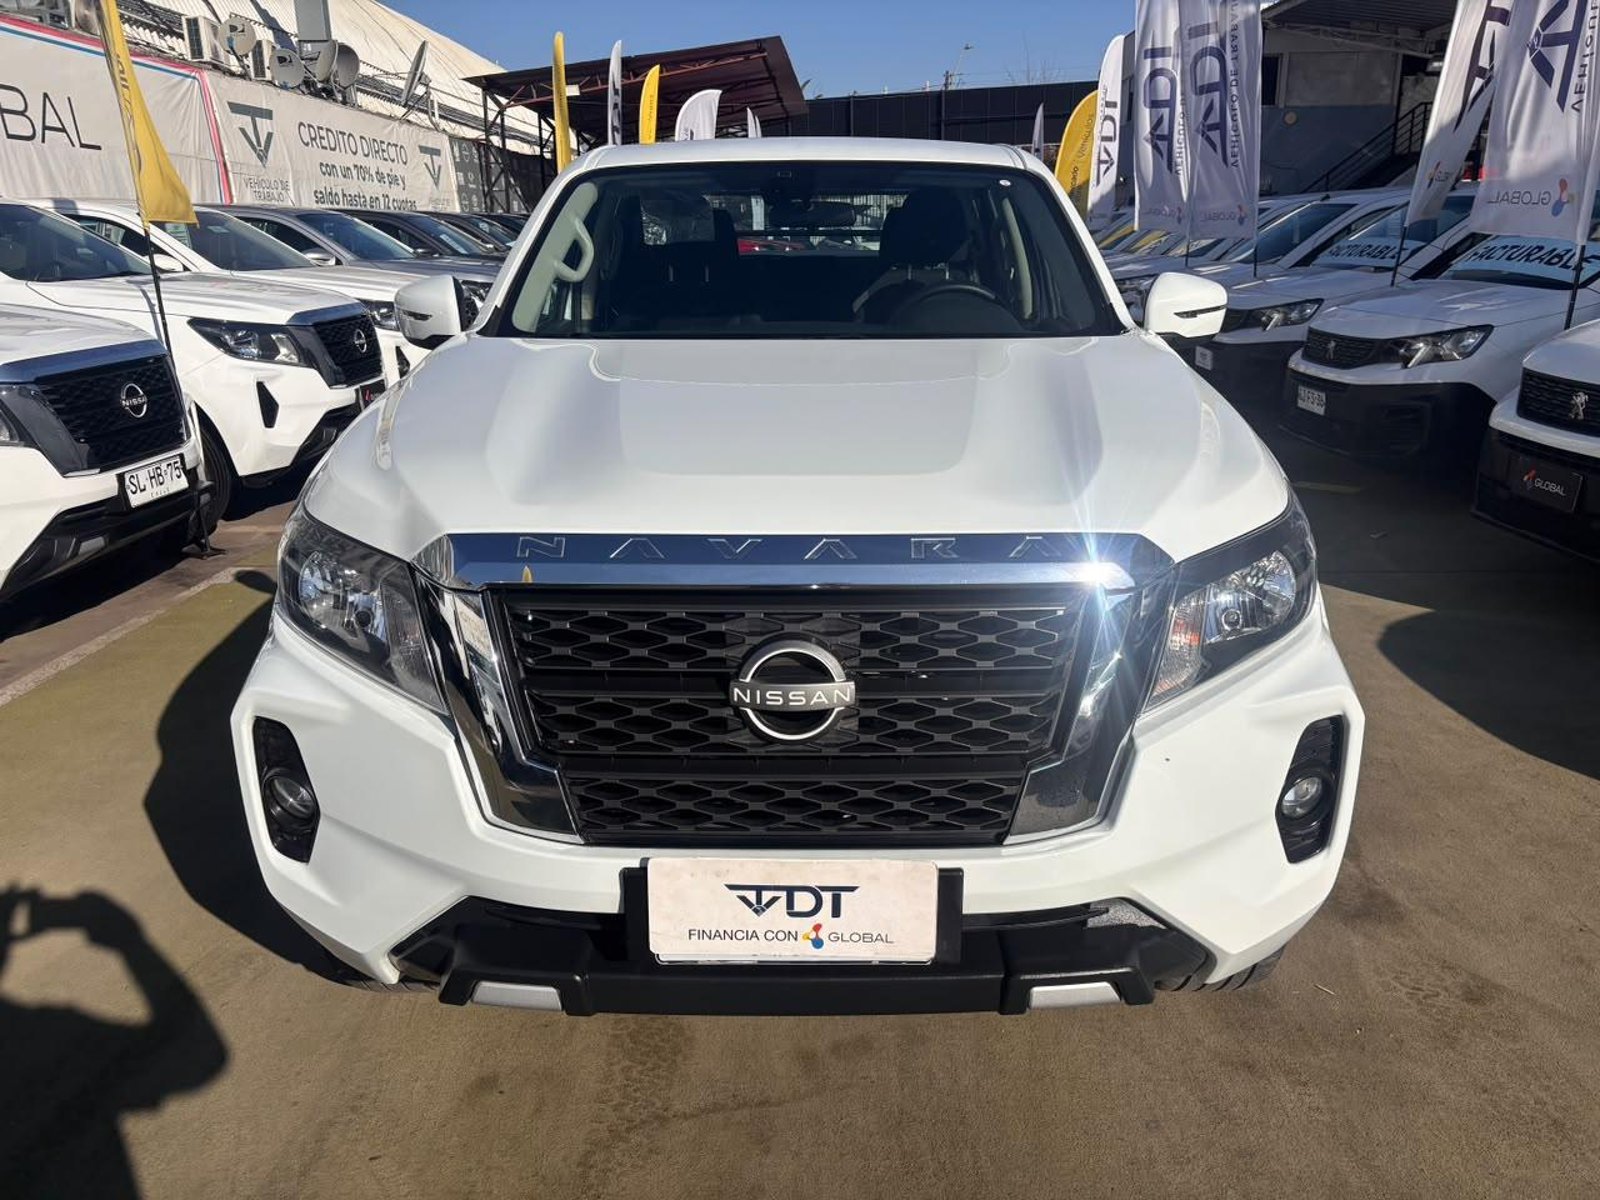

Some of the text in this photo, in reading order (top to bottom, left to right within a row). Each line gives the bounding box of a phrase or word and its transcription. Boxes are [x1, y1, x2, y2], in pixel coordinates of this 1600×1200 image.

[298, 121, 408, 166] CREDITO DIRECTO
[319, 161, 406, 191] con un 70% de pie y
[314, 186, 340, 206] saldo
[342, 188, 368, 208] hasta
[369, 195, 381, 210] en
[381, 193, 390, 211] 12
[1534, 478, 1567, 496] GLOBAL
[516, 536, 1062, 560] NAVARA
[733, 684, 853, 706] NISSAN
[687, 928, 895, 945] FINANCIA CON GLOBAL
